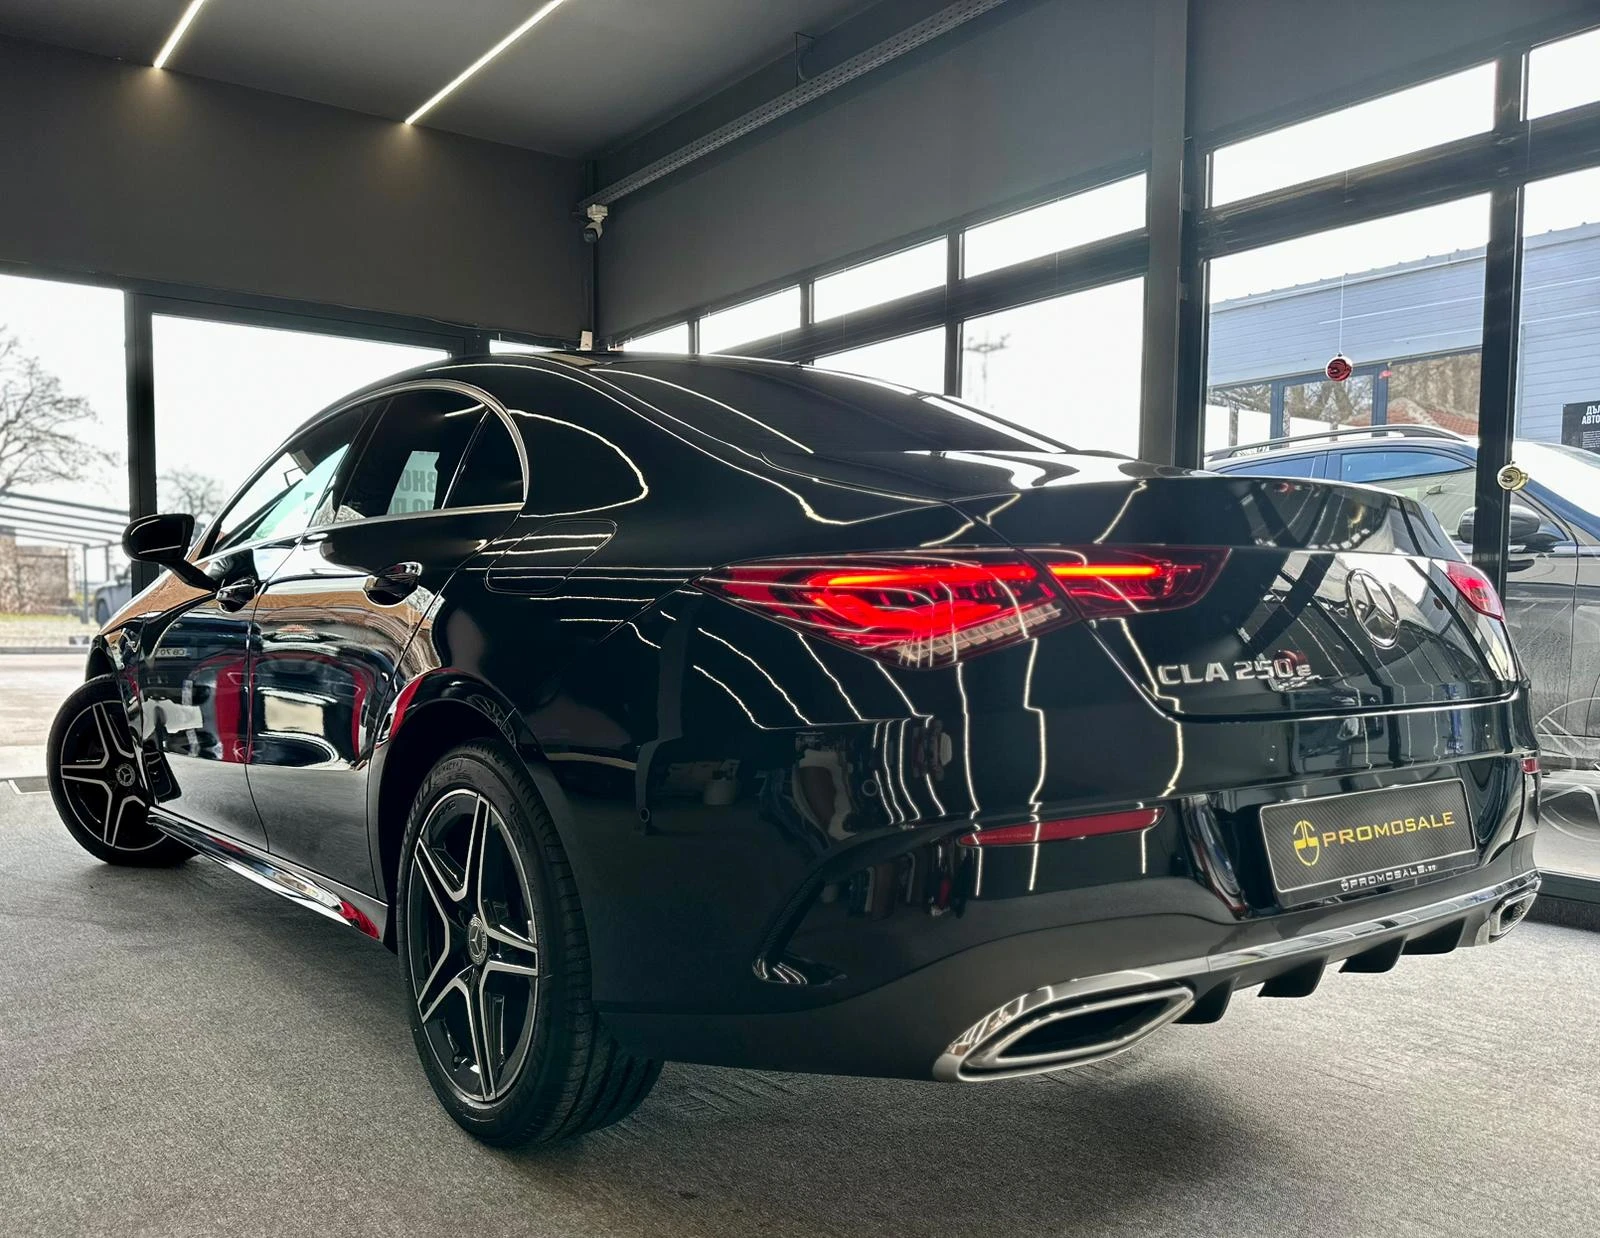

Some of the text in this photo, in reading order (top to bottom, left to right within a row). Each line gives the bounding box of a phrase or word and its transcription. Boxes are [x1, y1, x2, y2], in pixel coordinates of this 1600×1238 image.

[1157, 662, 1229, 685] CLA
[1233, 658, 1293, 680] 250
[1322, 811, 1455, 847] PROMOSALE
